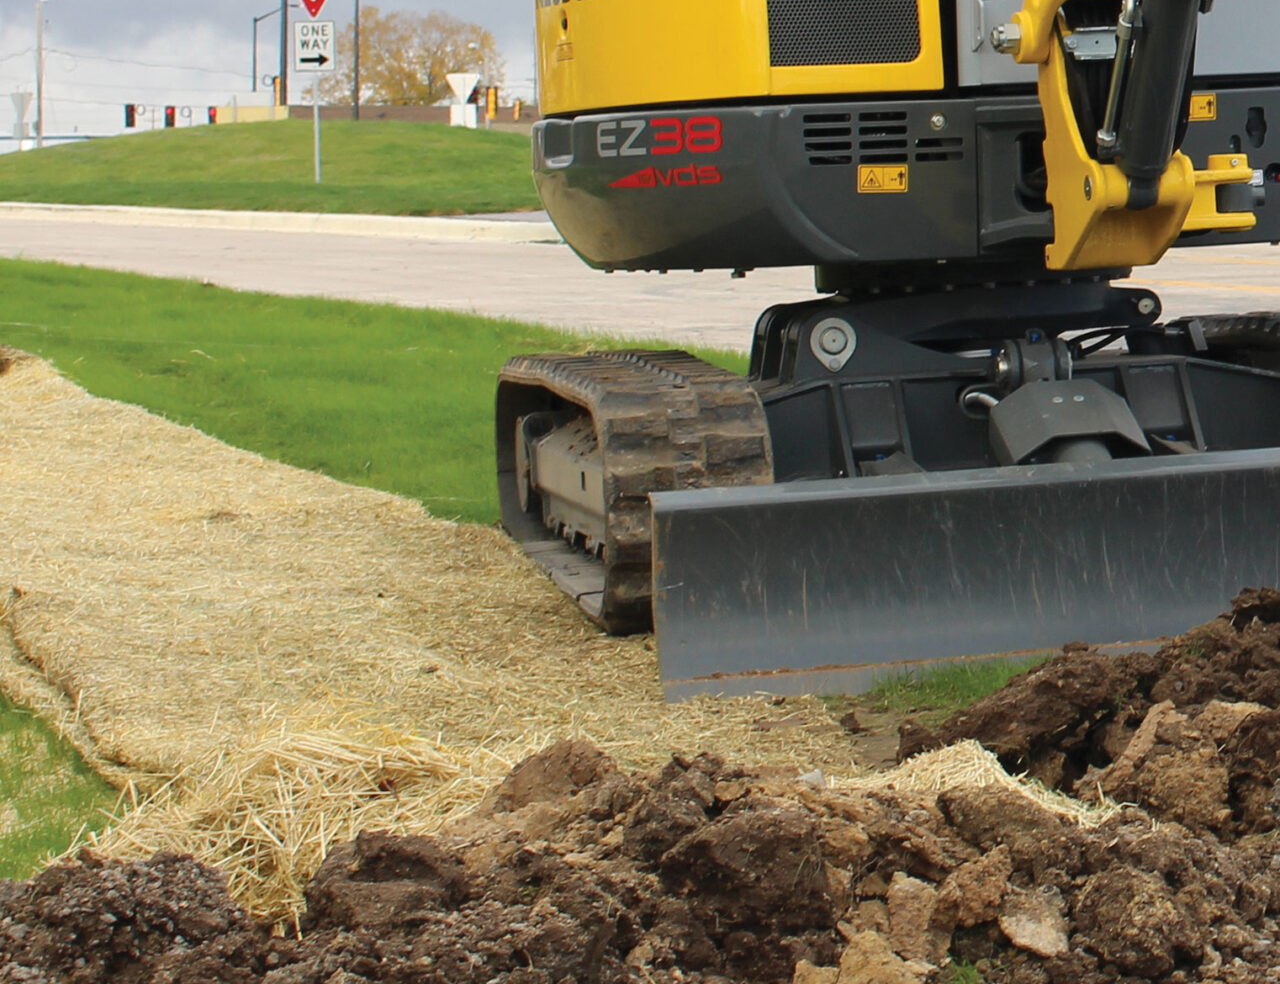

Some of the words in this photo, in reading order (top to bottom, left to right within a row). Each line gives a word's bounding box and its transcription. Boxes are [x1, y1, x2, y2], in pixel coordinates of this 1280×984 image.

[301, 25, 328, 37] ONE
[301, 39, 329, 50] WAY
[597, 116, 723, 157] EZ38
